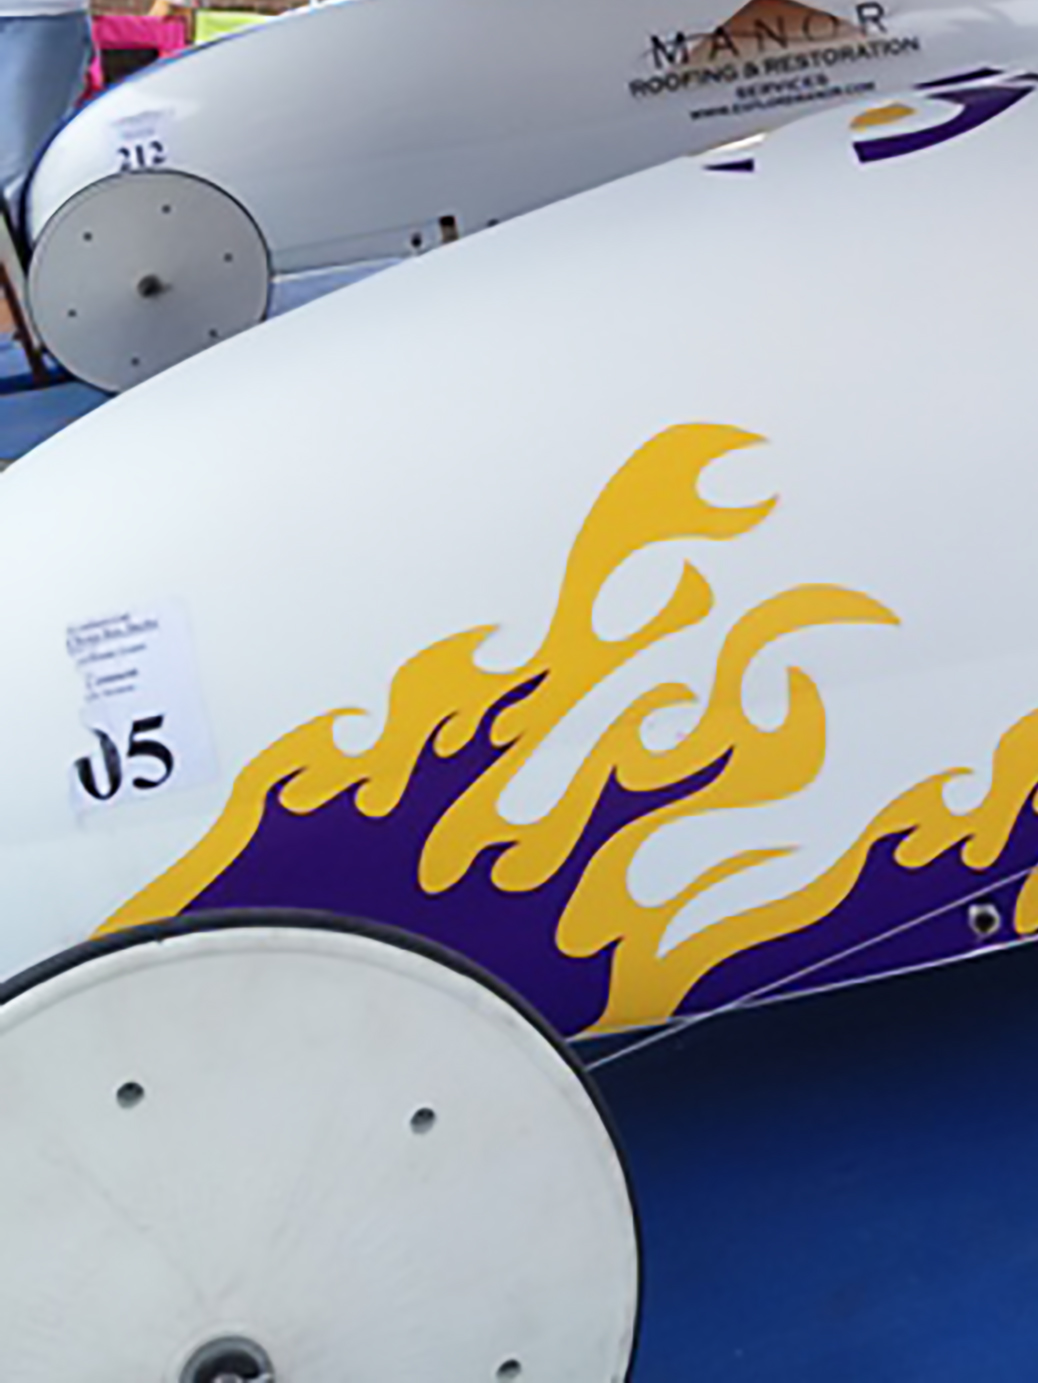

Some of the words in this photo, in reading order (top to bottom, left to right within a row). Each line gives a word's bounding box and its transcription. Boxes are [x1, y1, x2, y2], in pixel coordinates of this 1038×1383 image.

[650, 1, 888, 68] MANOR
[629, 64, 738, 98] ROOFING
[743, 61, 760, 80] &
[764, 36, 920, 77] RESTORATION
[736, 74, 830, 99] SERVICES
[117, 141, 166, 173] 212
